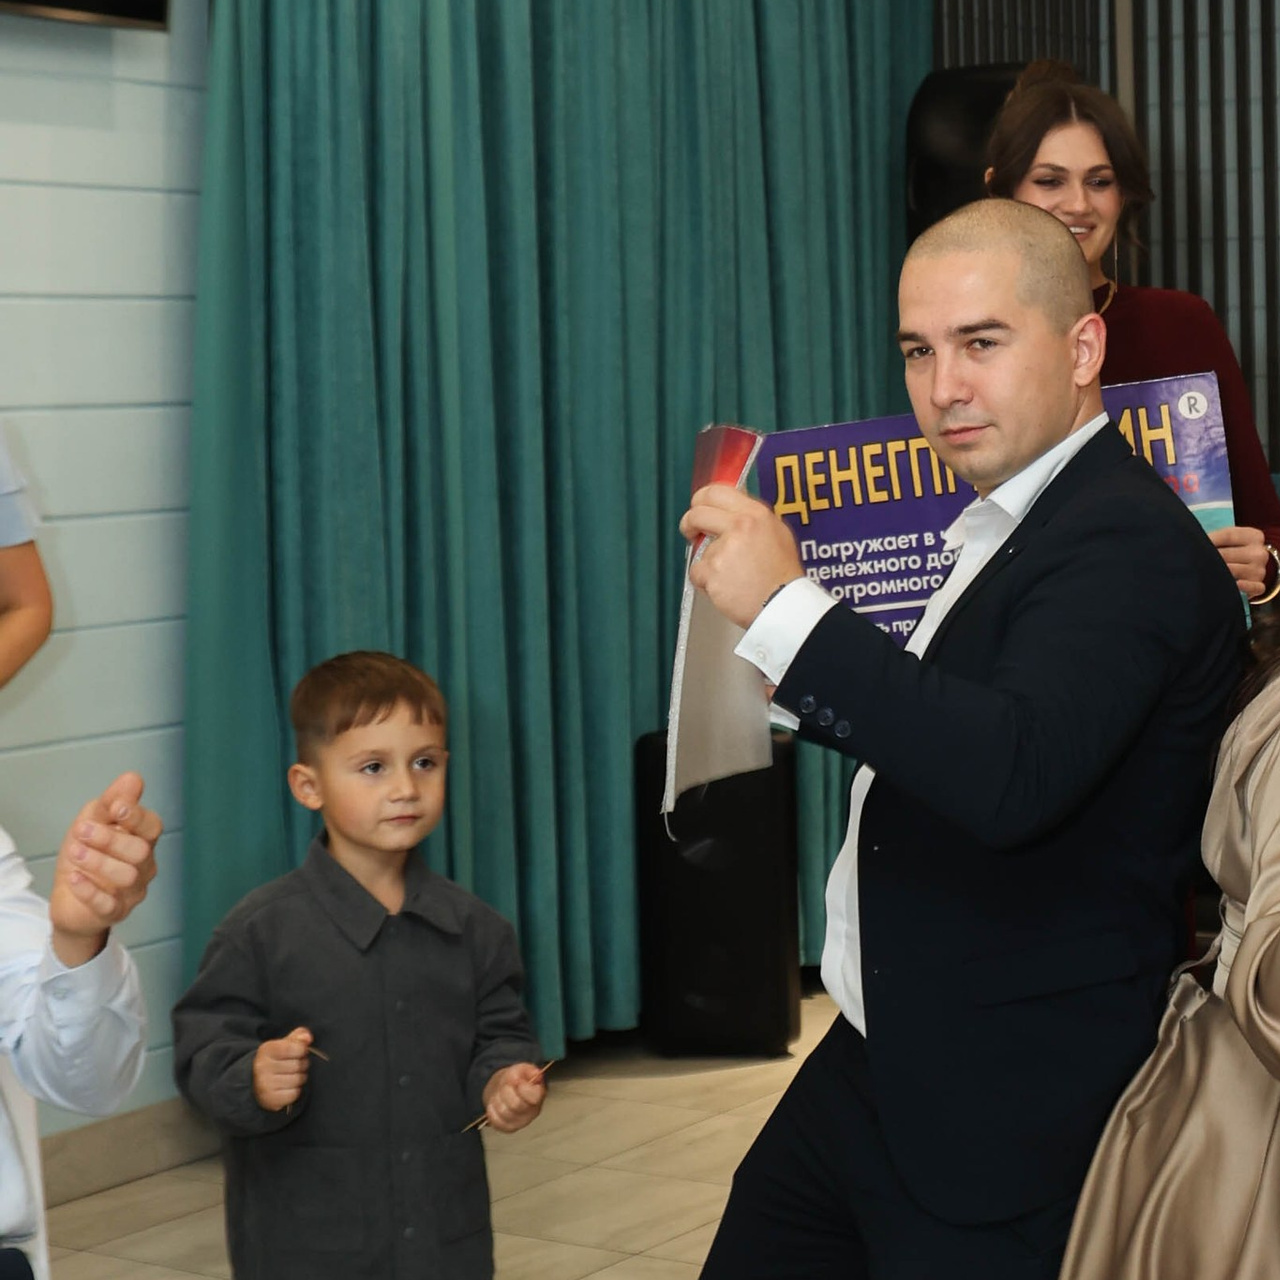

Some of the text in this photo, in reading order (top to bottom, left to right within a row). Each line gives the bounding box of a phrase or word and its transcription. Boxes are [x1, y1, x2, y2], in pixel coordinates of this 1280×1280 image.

[801, 532, 919, 562] Погружает
[923, 532, 936, 546] в
[806, 556, 922, 584] денежного
[831, 575, 944, 604] огромного
